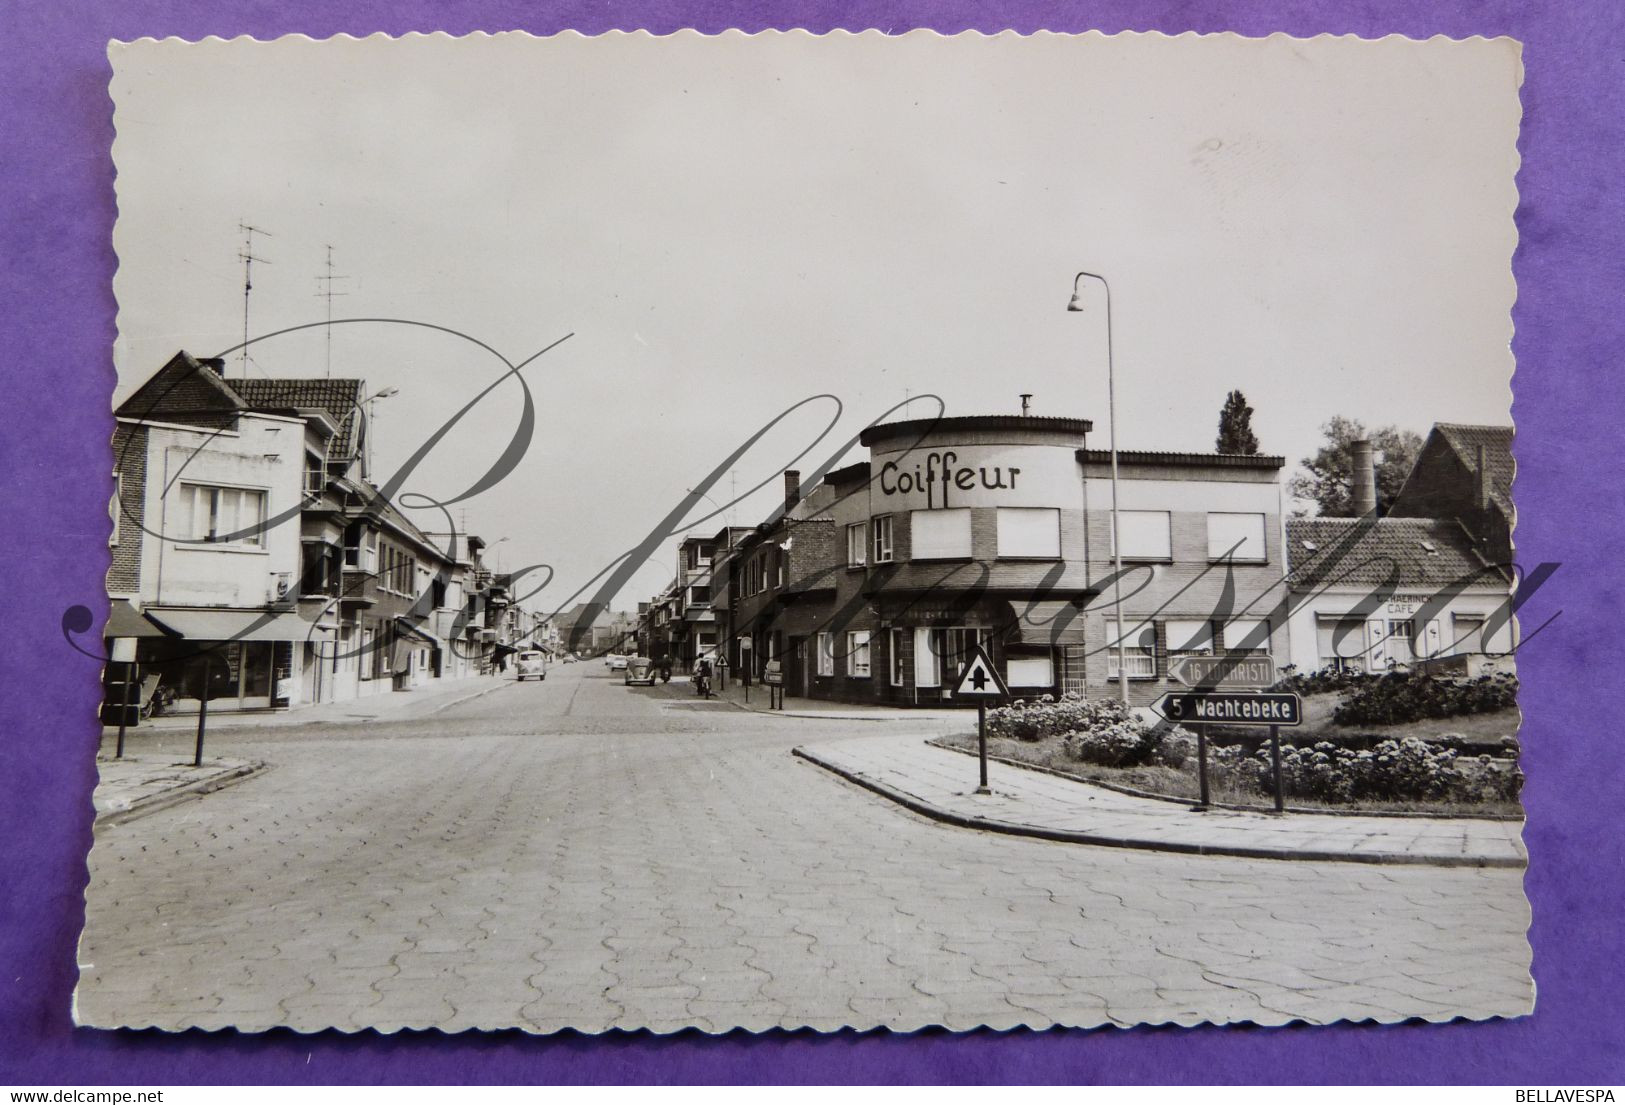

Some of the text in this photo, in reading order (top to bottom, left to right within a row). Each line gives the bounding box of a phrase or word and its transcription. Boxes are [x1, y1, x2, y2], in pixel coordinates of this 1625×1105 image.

[881, 452, 1020, 509] Coiffeur
[1388, 604, 1414, 613] CAFE
[1189, 663, 1269, 682] 16 LOCHRISTI
[1172, 698, 1291, 719] 5 Wachtebeke
